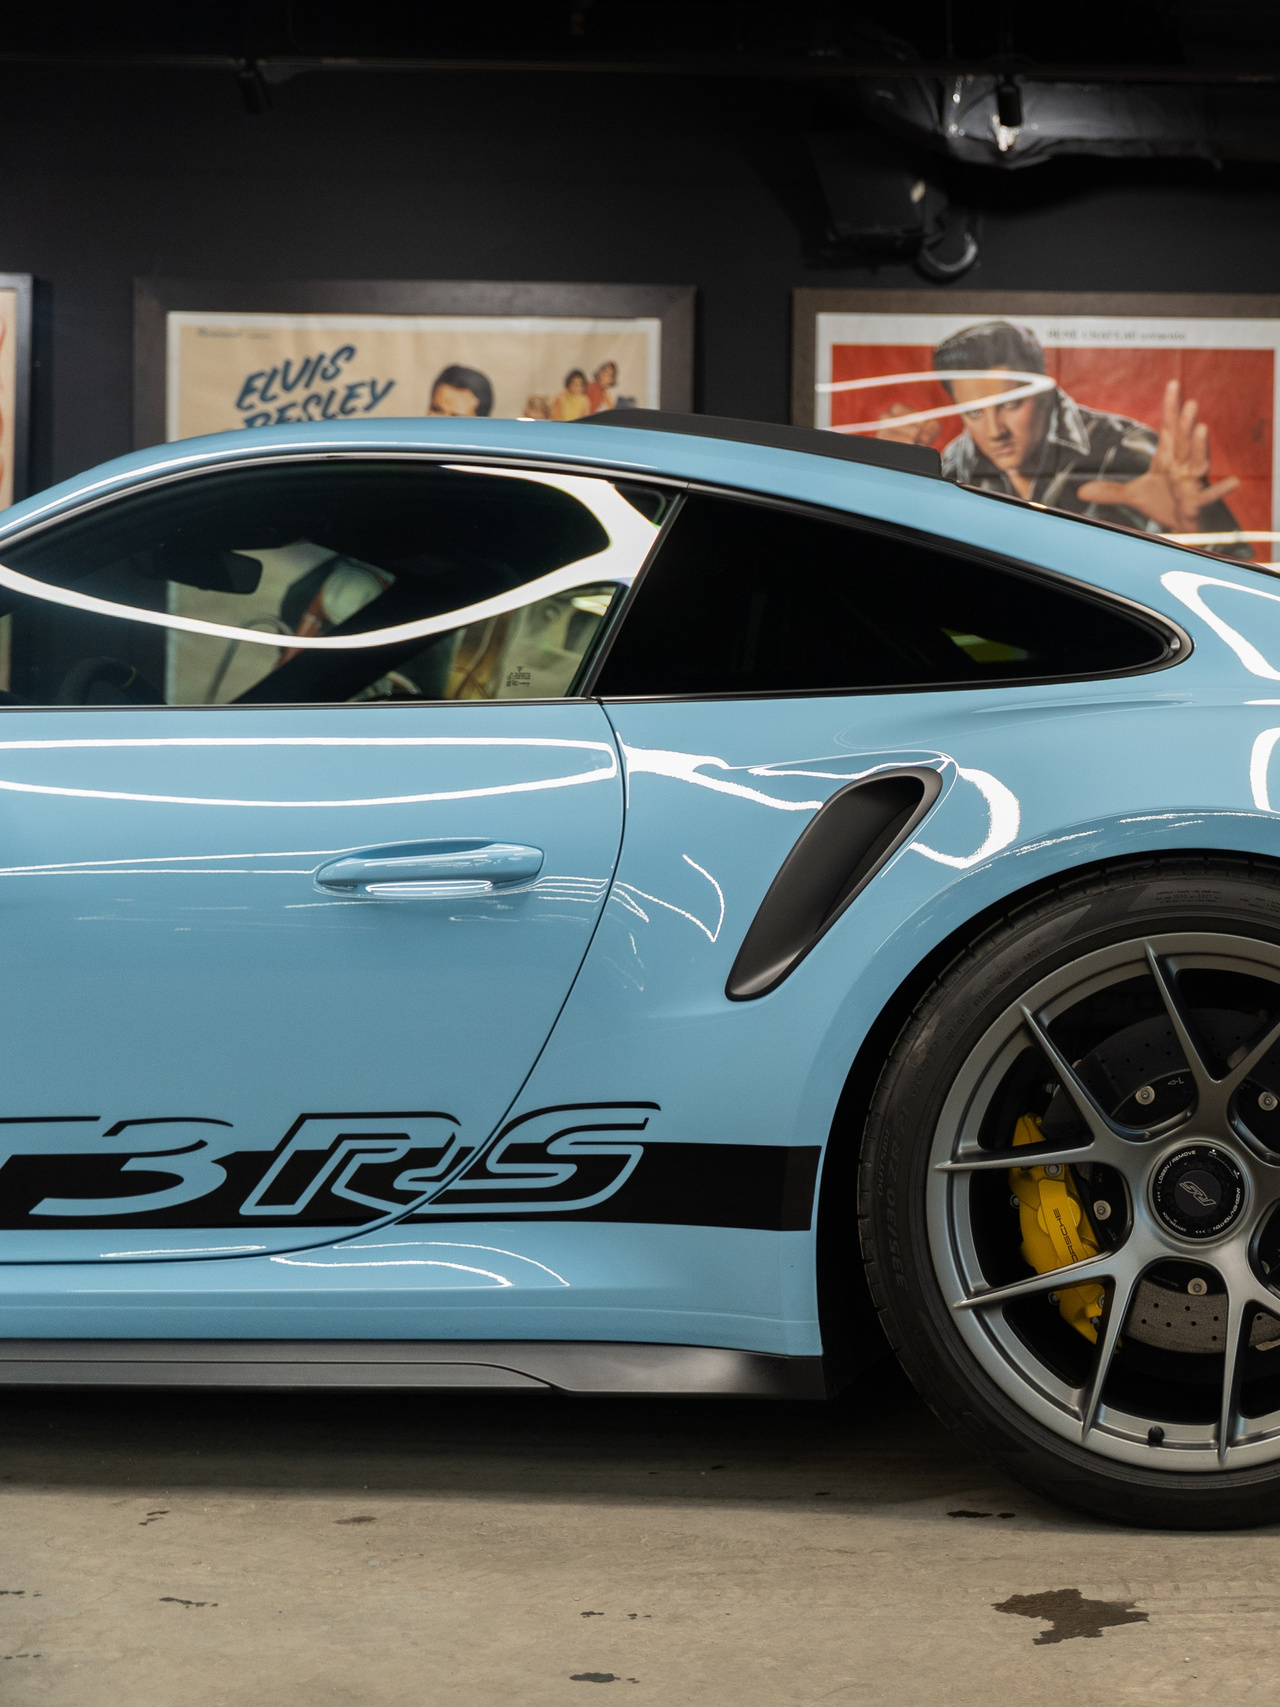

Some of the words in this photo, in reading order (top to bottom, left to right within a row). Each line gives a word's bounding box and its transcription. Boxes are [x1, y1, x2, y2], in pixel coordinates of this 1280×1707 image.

[236, 343, 357, 411] ELVIS
[241, 379, 397, 428] ESLEY
[239, 1100, 662, 1215] RS
[1171, 1149, 1196, 1164] REMOVE
[1052, 1208, 1079, 1263] ORSCHE
